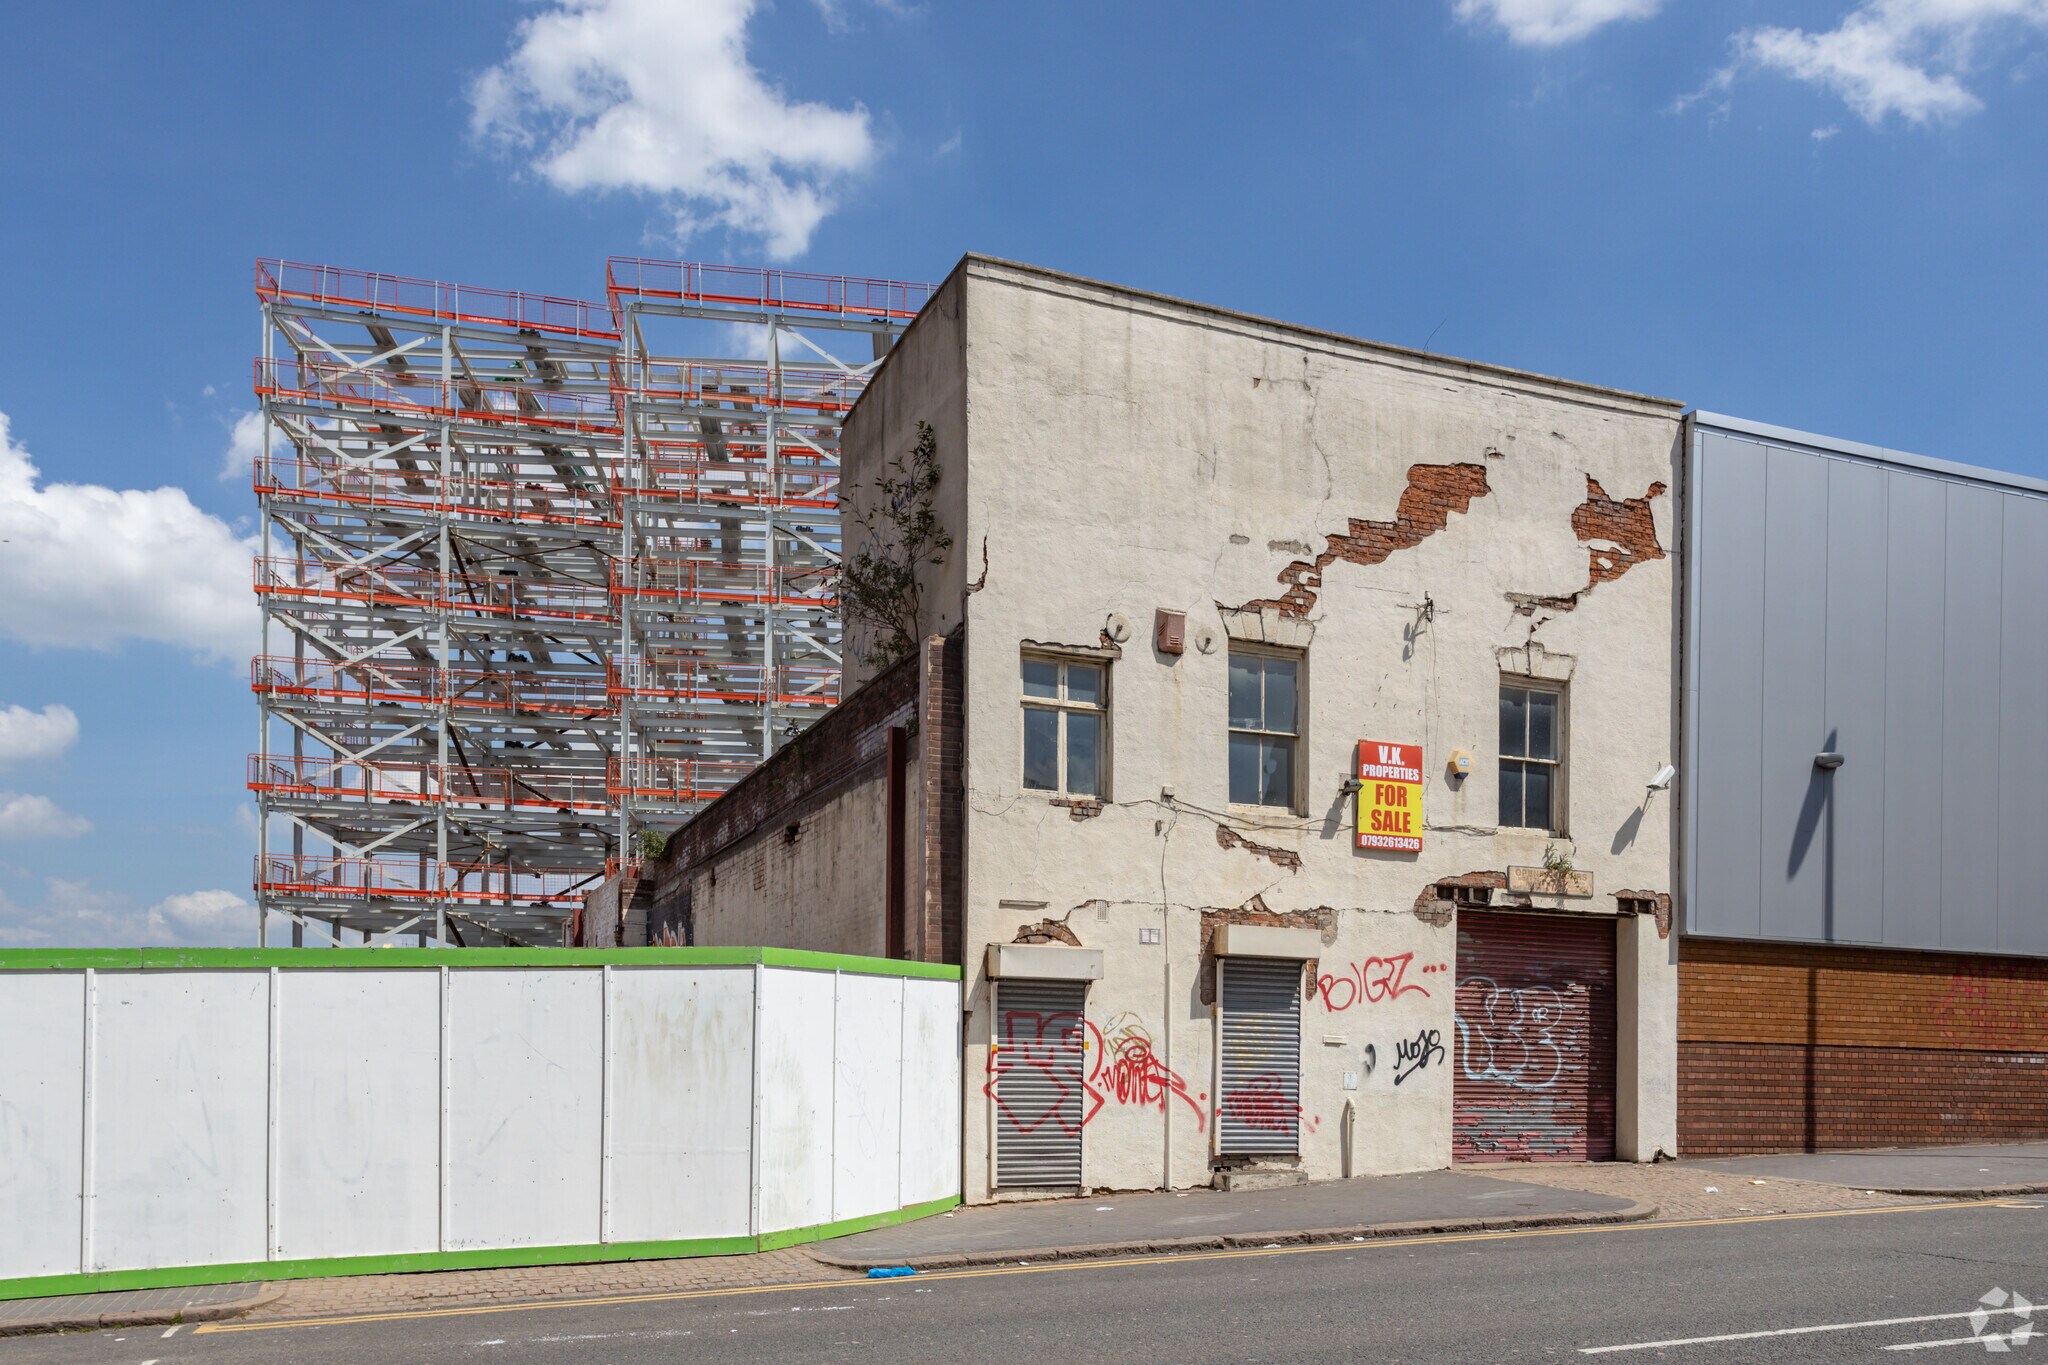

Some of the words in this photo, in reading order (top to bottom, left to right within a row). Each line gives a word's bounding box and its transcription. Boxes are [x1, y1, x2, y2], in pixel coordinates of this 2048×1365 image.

[1378, 745, 1405, 765] V.K.
[1362, 763, 1419, 781] PROPERTIES
[1375, 783, 1407, 807] FOR
[1371, 809, 1411, 833] SALE
[1361, 834, 1420, 849] 07932613426
